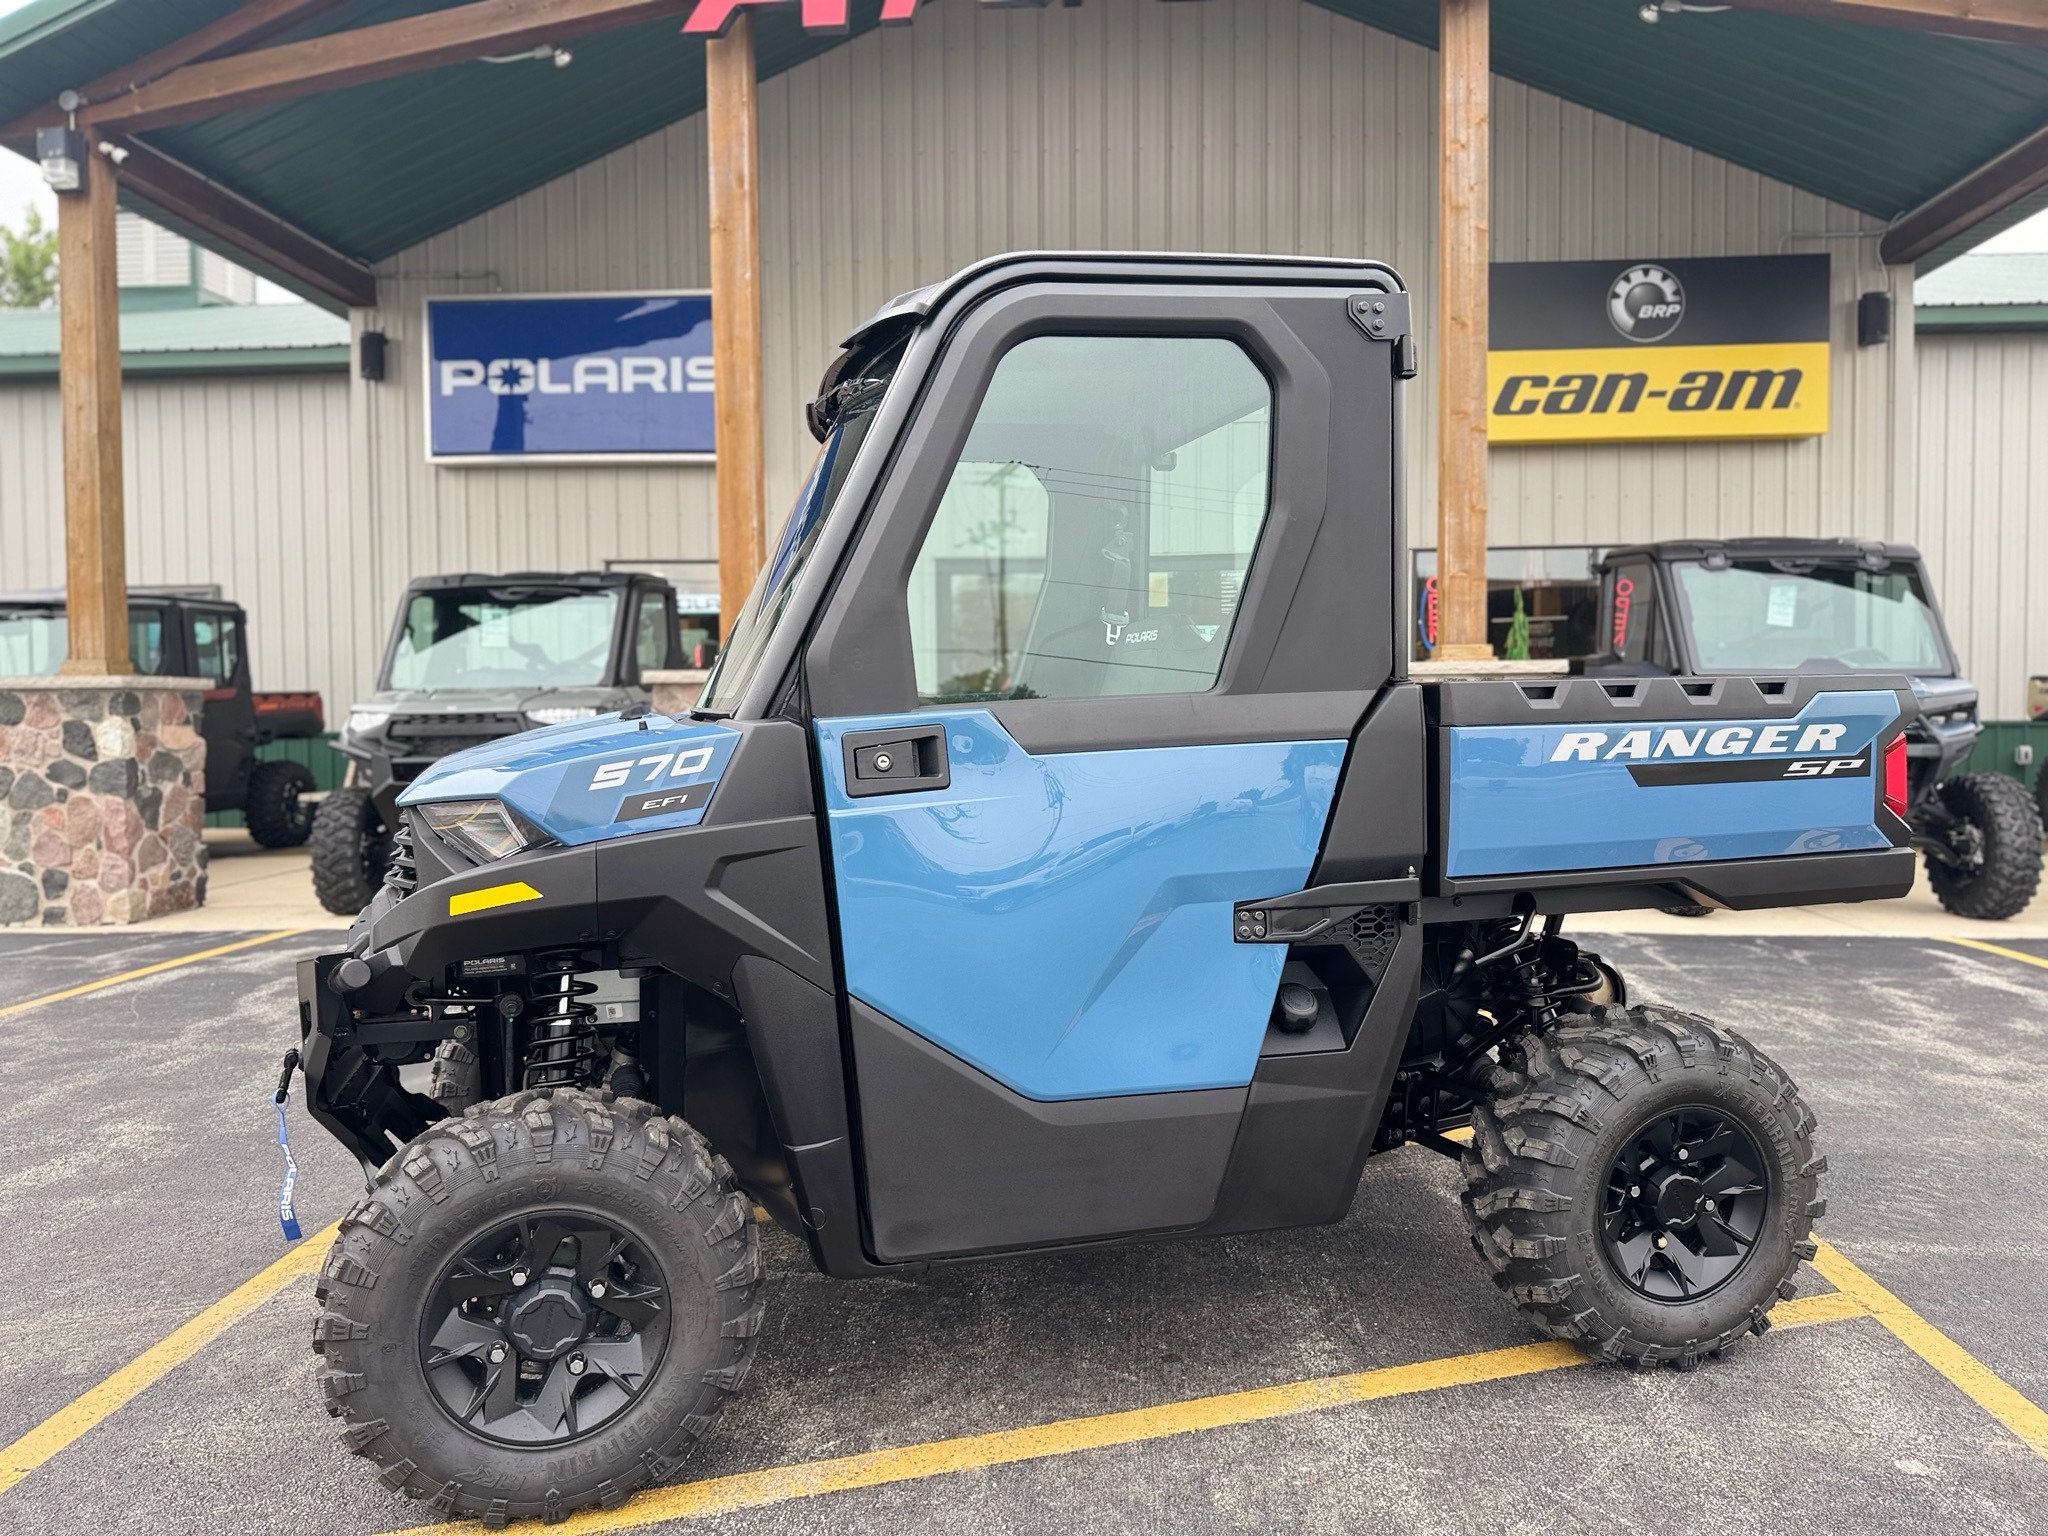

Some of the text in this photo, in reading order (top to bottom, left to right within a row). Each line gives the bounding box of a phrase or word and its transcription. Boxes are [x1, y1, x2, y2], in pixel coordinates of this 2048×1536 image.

[1638, 304, 1682, 319] BRP
[440, 355, 715, 397] POLARIS
[1492, 368, 1803, 416] can-am
[1125, 629, 1158, 645] POLARIS
[1550, 723, 1847, 762] RANGER
[1783, 759, 1866, 777] SP
[641, 794, 689, 811] EFI
[463, 956, 506, 966] POLARIS
[1713, 1080, 1798, 1182] X-TERRAIN
[281, 1143, 297, 1221] POLARIS
